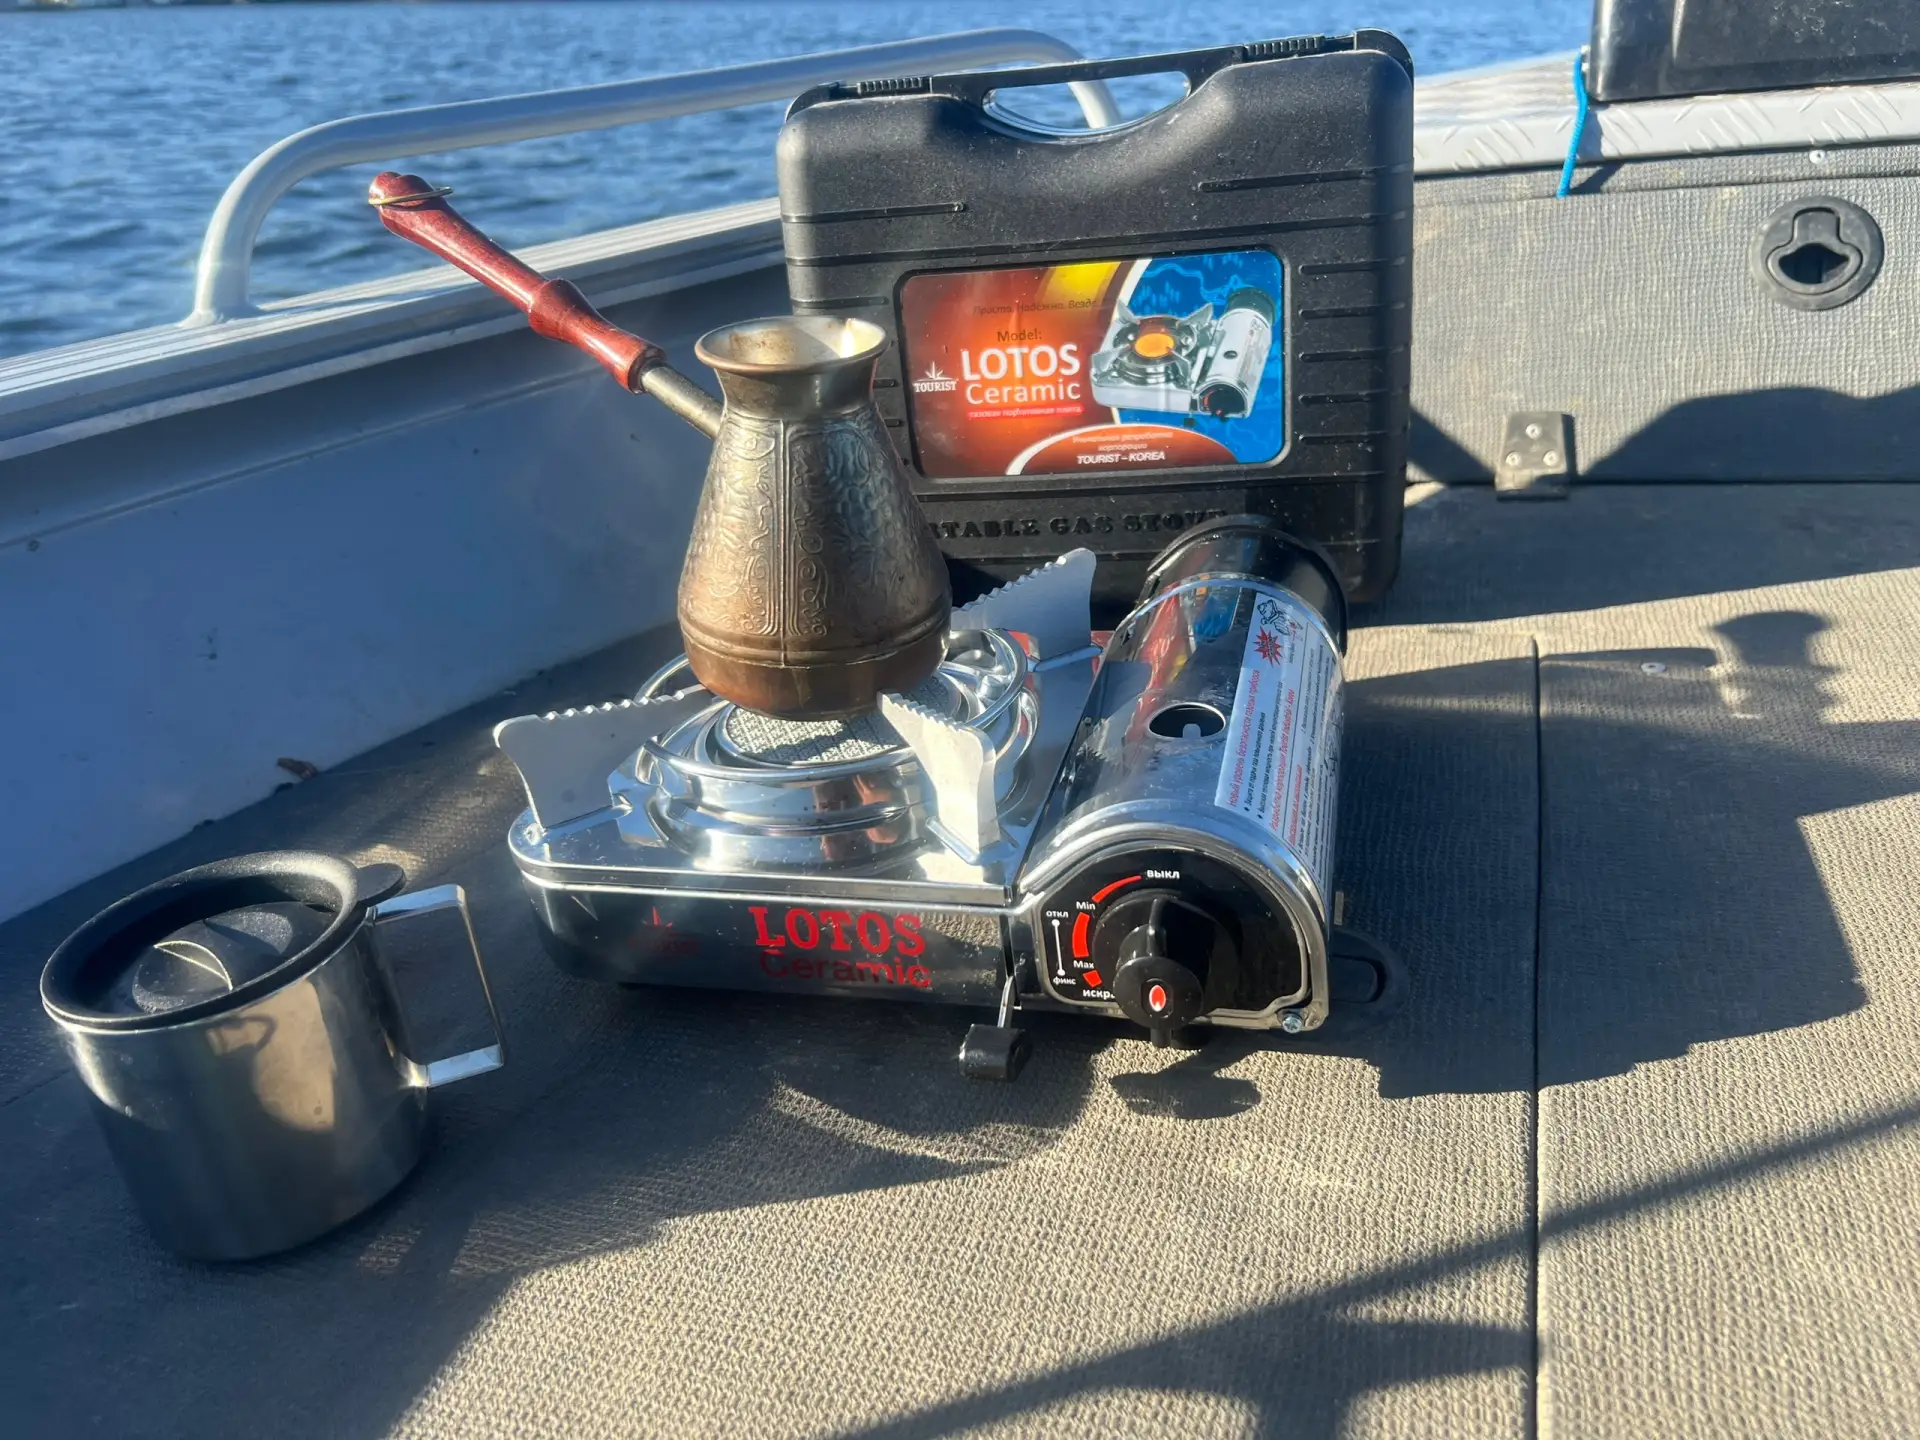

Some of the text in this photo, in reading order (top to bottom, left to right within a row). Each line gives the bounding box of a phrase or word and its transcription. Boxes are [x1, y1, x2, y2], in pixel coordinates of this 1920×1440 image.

[997, 327, 1042, 342] Model:
[961, 343, 1081, 381] LOTOS
[913, 381, 957, 393] TOURIST
[966, 378, 1081, 405] Ceramic
[1077, 454, 1121, 465] TOURIST
[1129, 451, 1166, 462] KOREA
[1050, 516, 1114, 535] GAS
[1147, 869, 1180, 879] выкл
[1076, 901, 1096, 910] Min
[1046, 910, 1069, 918] откл
[748, 906, 926, 957] LOTOS
[760, 948, 932, 987] Ceramic
[1073, 960, 1094, 969] Max
[1053, 975, 1076, 986] фикс
